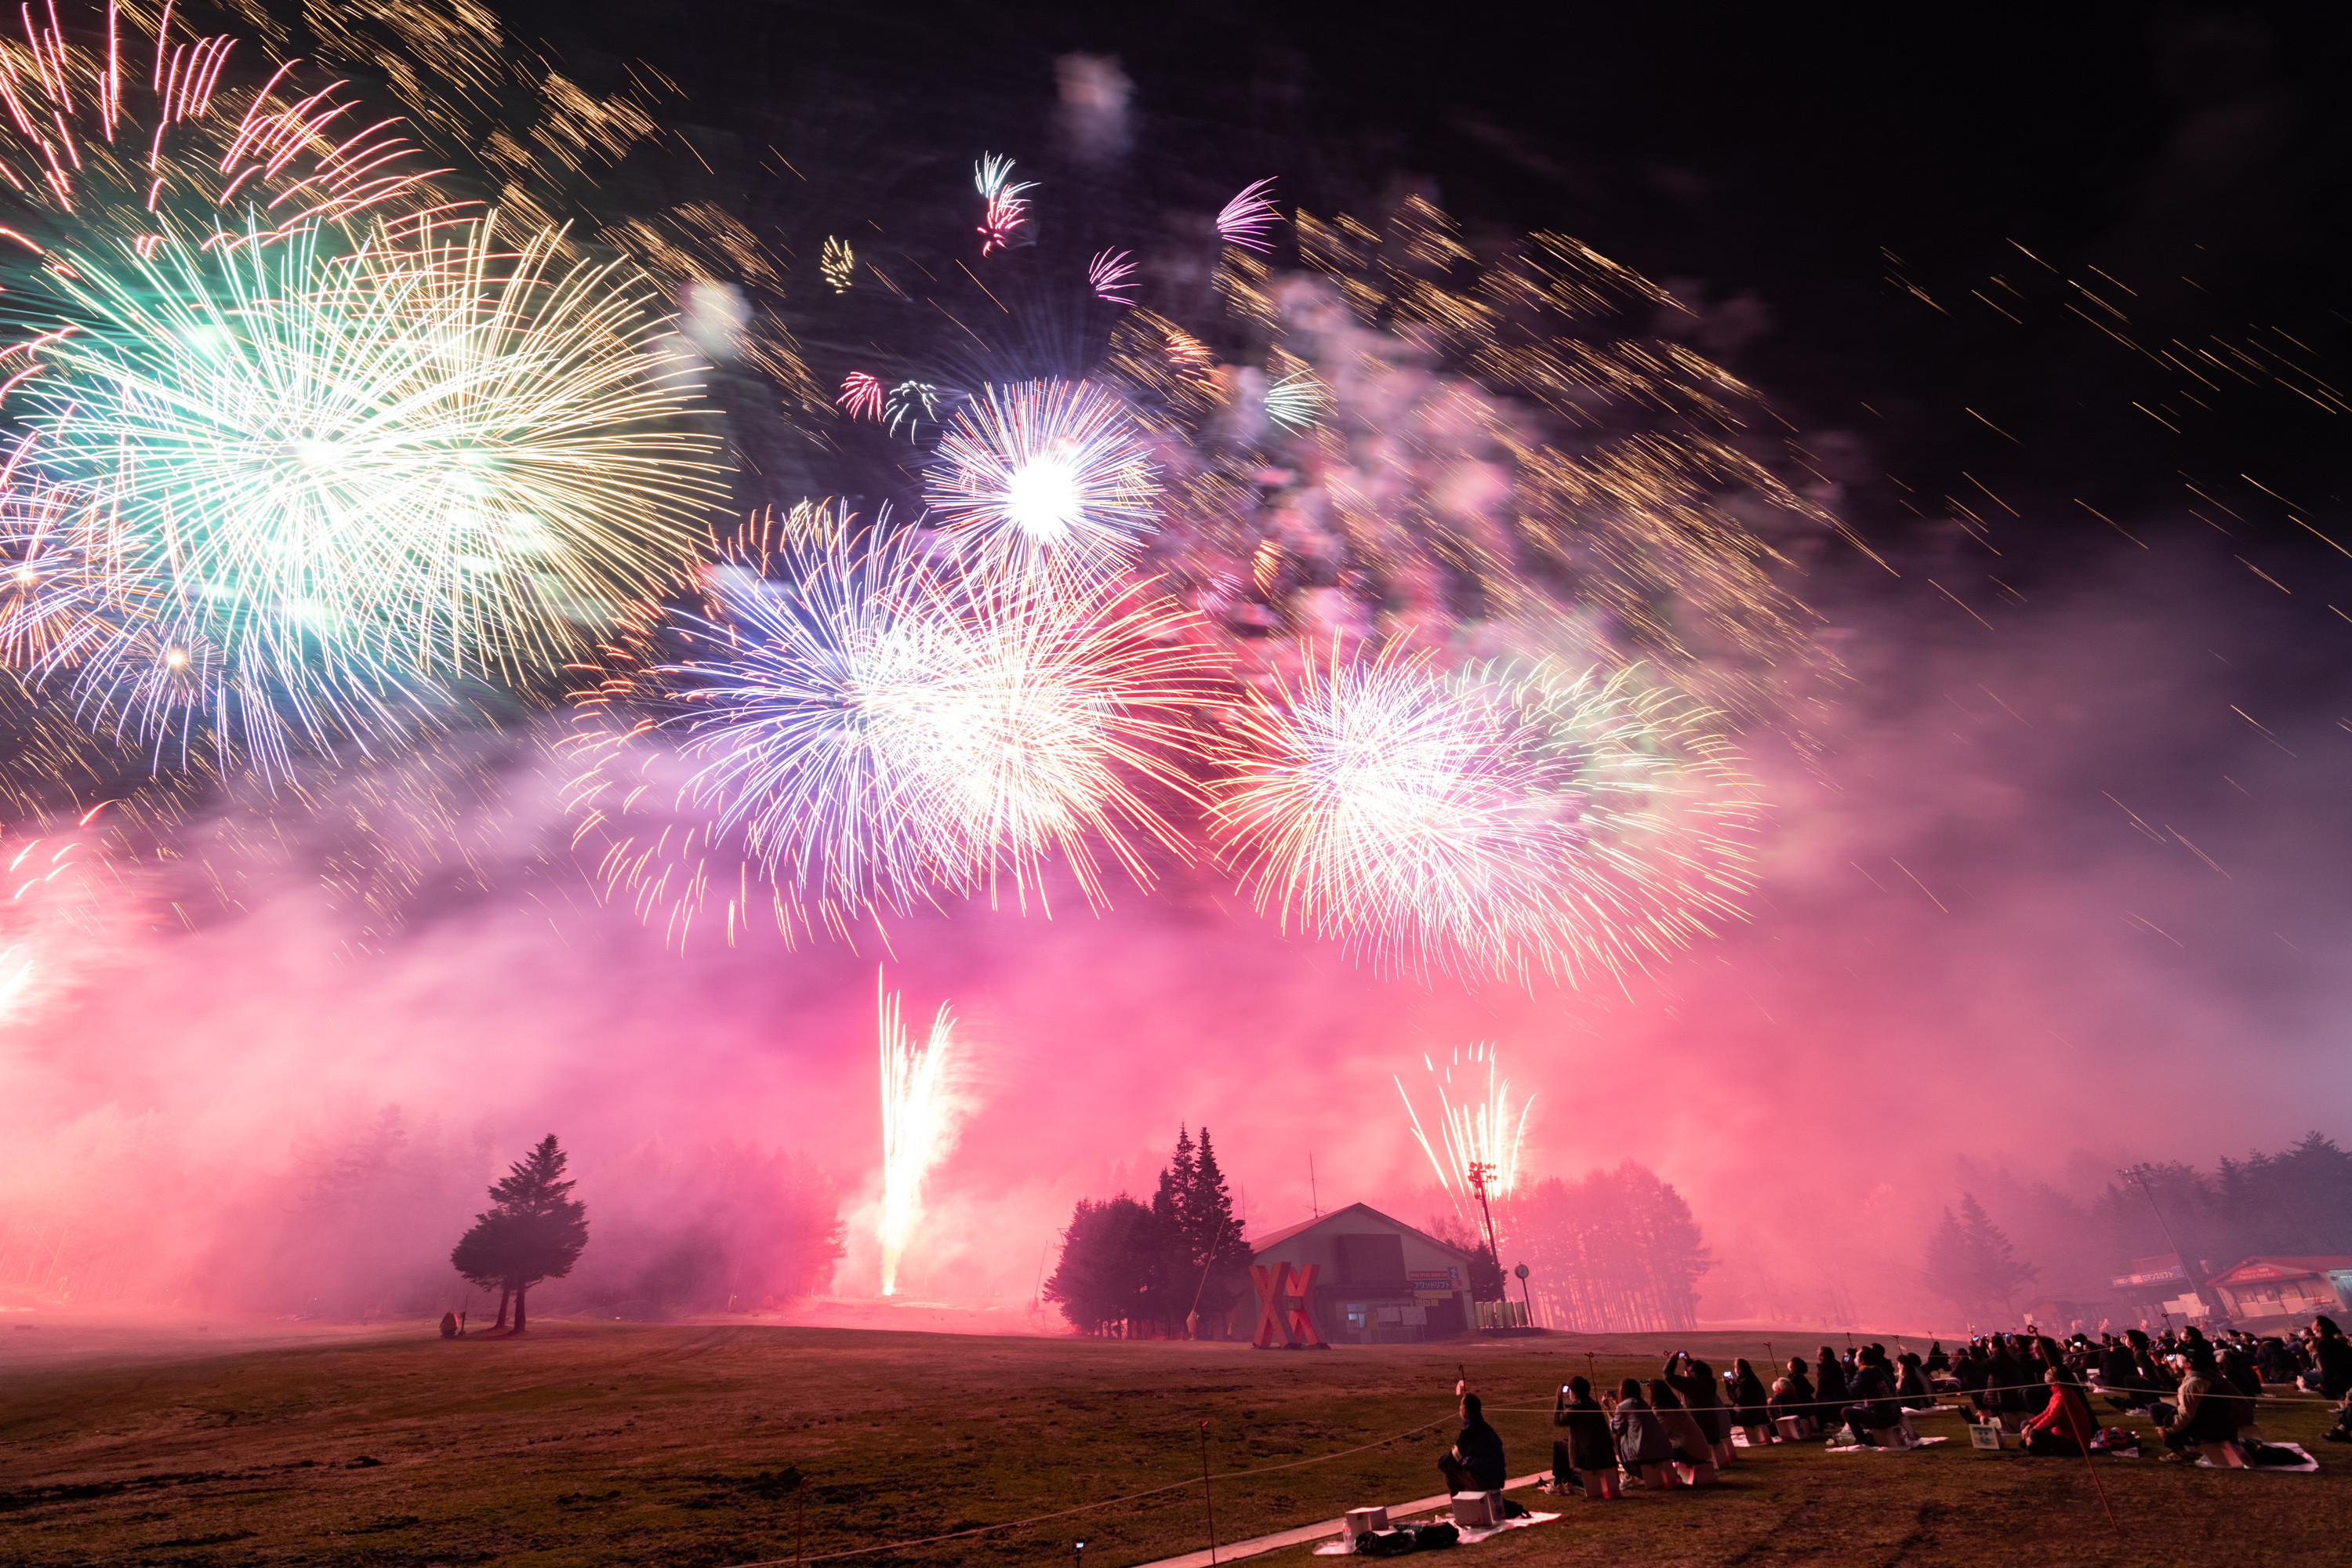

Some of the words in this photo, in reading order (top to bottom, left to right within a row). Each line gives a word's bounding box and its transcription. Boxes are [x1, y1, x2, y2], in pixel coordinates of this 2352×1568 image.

[2143, 1271, 2174, 1281] ロマンスリフト
